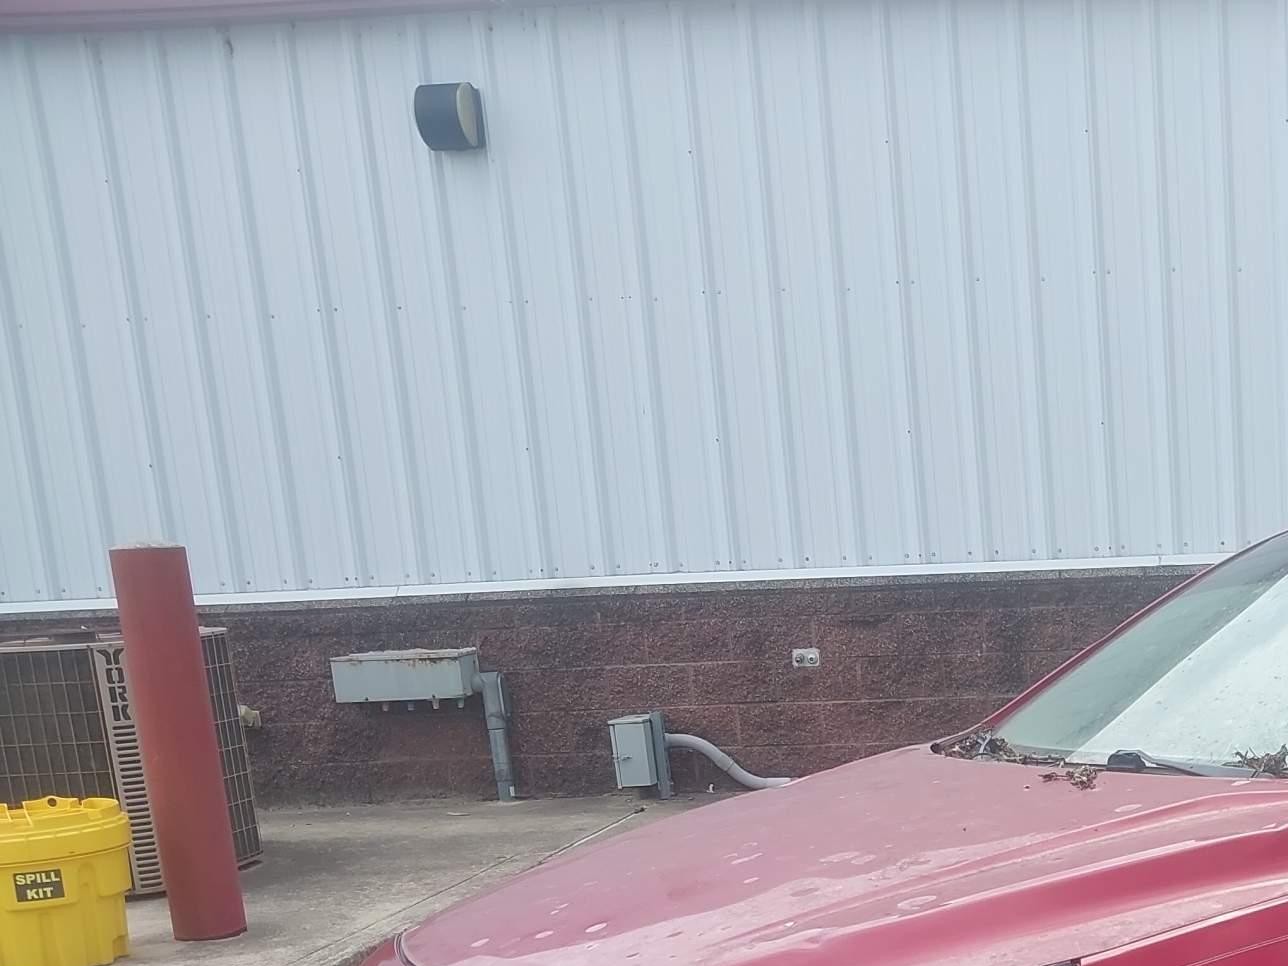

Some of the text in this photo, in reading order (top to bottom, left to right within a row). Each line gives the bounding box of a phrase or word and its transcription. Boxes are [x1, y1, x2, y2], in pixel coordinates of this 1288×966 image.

[96, 647, 132, 721] YORK
[15, 871, 61, 885] SPILL
[26, 886, 54, 900] KIT
